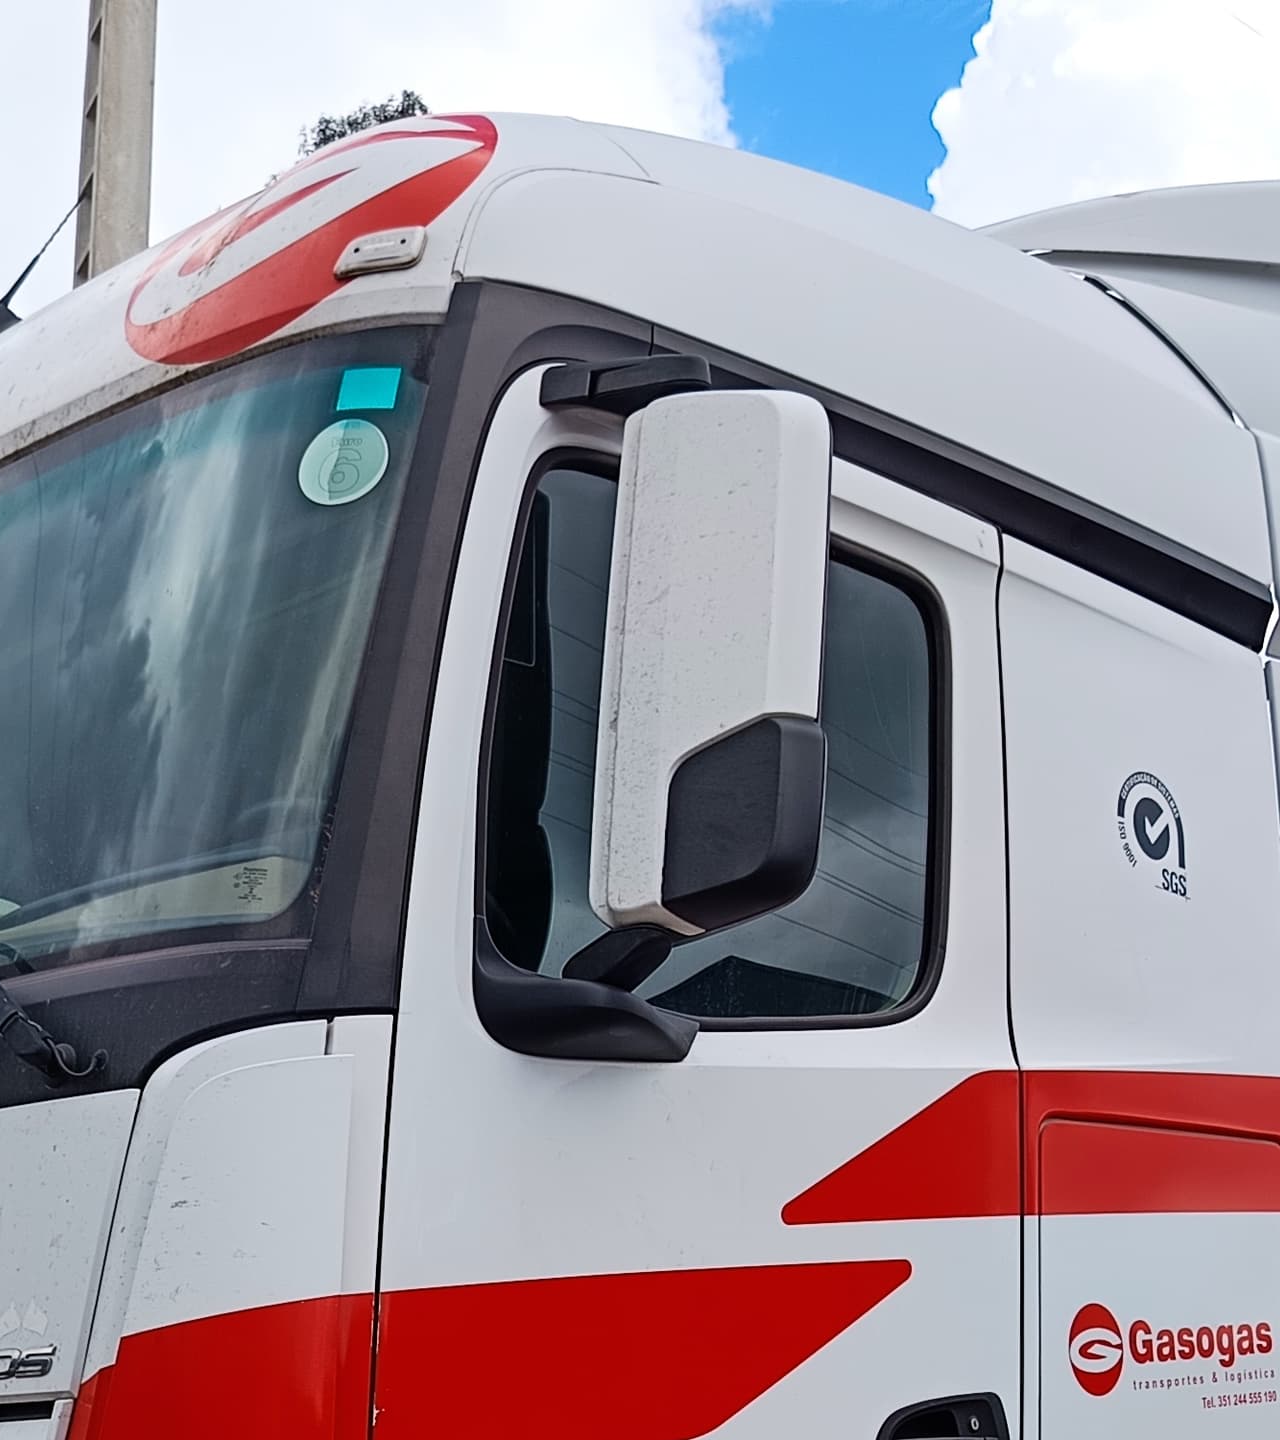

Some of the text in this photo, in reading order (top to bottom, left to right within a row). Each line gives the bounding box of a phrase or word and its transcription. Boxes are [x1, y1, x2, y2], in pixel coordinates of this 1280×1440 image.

[1117, 820, 1127, 840] ISO
[1161, 868, 1187, 897] SGS
[1128, 1319, 1273, 1368] Gasogas
[1132, 1374, 1205, 1393] transportes
[1211, 1371, 1219, 1384] &
[1201, 1396, 1216, 1410] Tel.
[1218, 1394, 1232, 1408] 351
[1233, 1393, 1248, 1406] 244
[1248, 1391, 1263, 1405] 555
